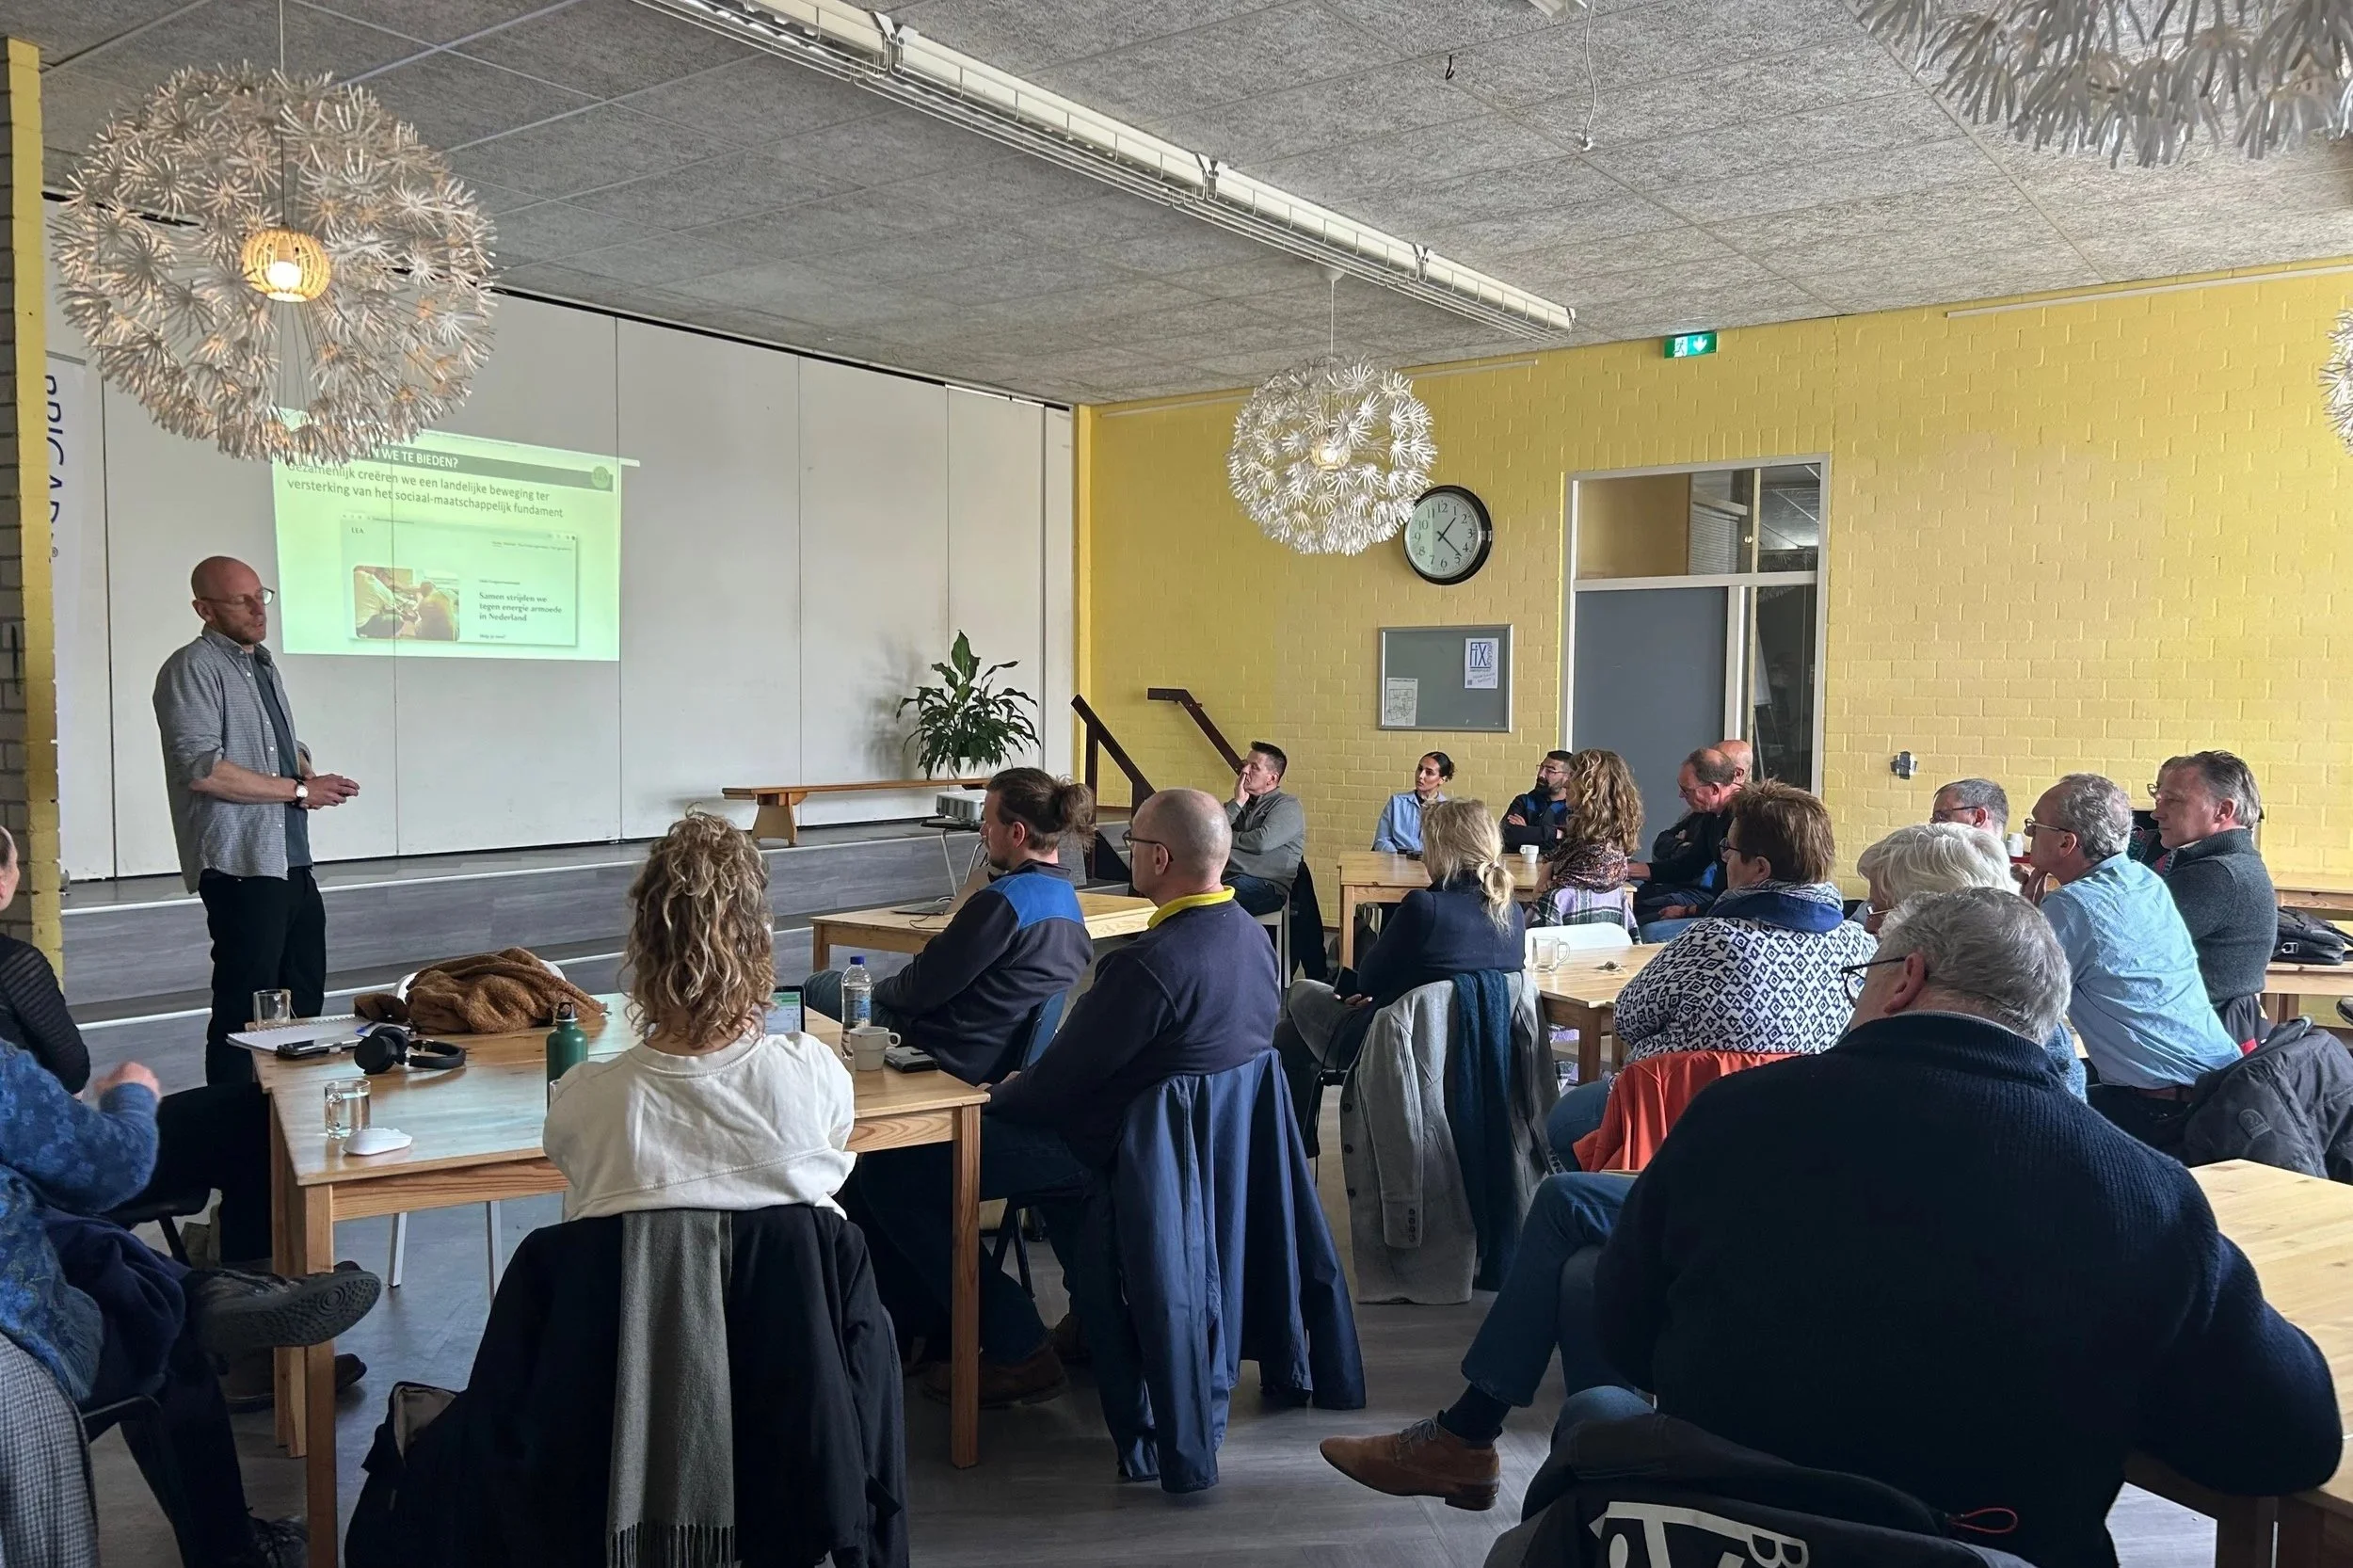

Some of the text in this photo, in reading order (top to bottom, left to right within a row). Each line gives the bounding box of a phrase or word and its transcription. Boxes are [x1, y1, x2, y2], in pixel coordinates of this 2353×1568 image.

[381, 448, 399, 461] WE
[401, 451, 414, 463] TE
[416, 453, 458, 469] BIEDEN?
[358, 470, 398, 484] creëren
[401, 475, 417, 487] we
[419, 477, 438, 488] een
[440, 478, 487, 495] landelijke
[489, 484, 534, 502] beweging
[536, 490, 550, 501] ter
[287, 478, 563, 518] versterking van het sociaal-maatschappelijk fundament
[1427, 508, 1435, 518] 11
[1437, 504, 1448, 513] 12
[1461, 514, 1467, 523] 2
[1418, 520, 1429, 530] 10
[1414, 533, 1421, 542] 9
[1467, 528, 1473, 538] 3
[1418, 547, 1426, 556] 8
[1463, 542, 1469, 552] 4
[1429, 555, 1435, 565] 7
[1440, 557, 1448, 568] 6
[479, 592, 504, 600] Samen
[479, 603, 501, 612] tegen
[479, 612, 527, 621] in Nederland
